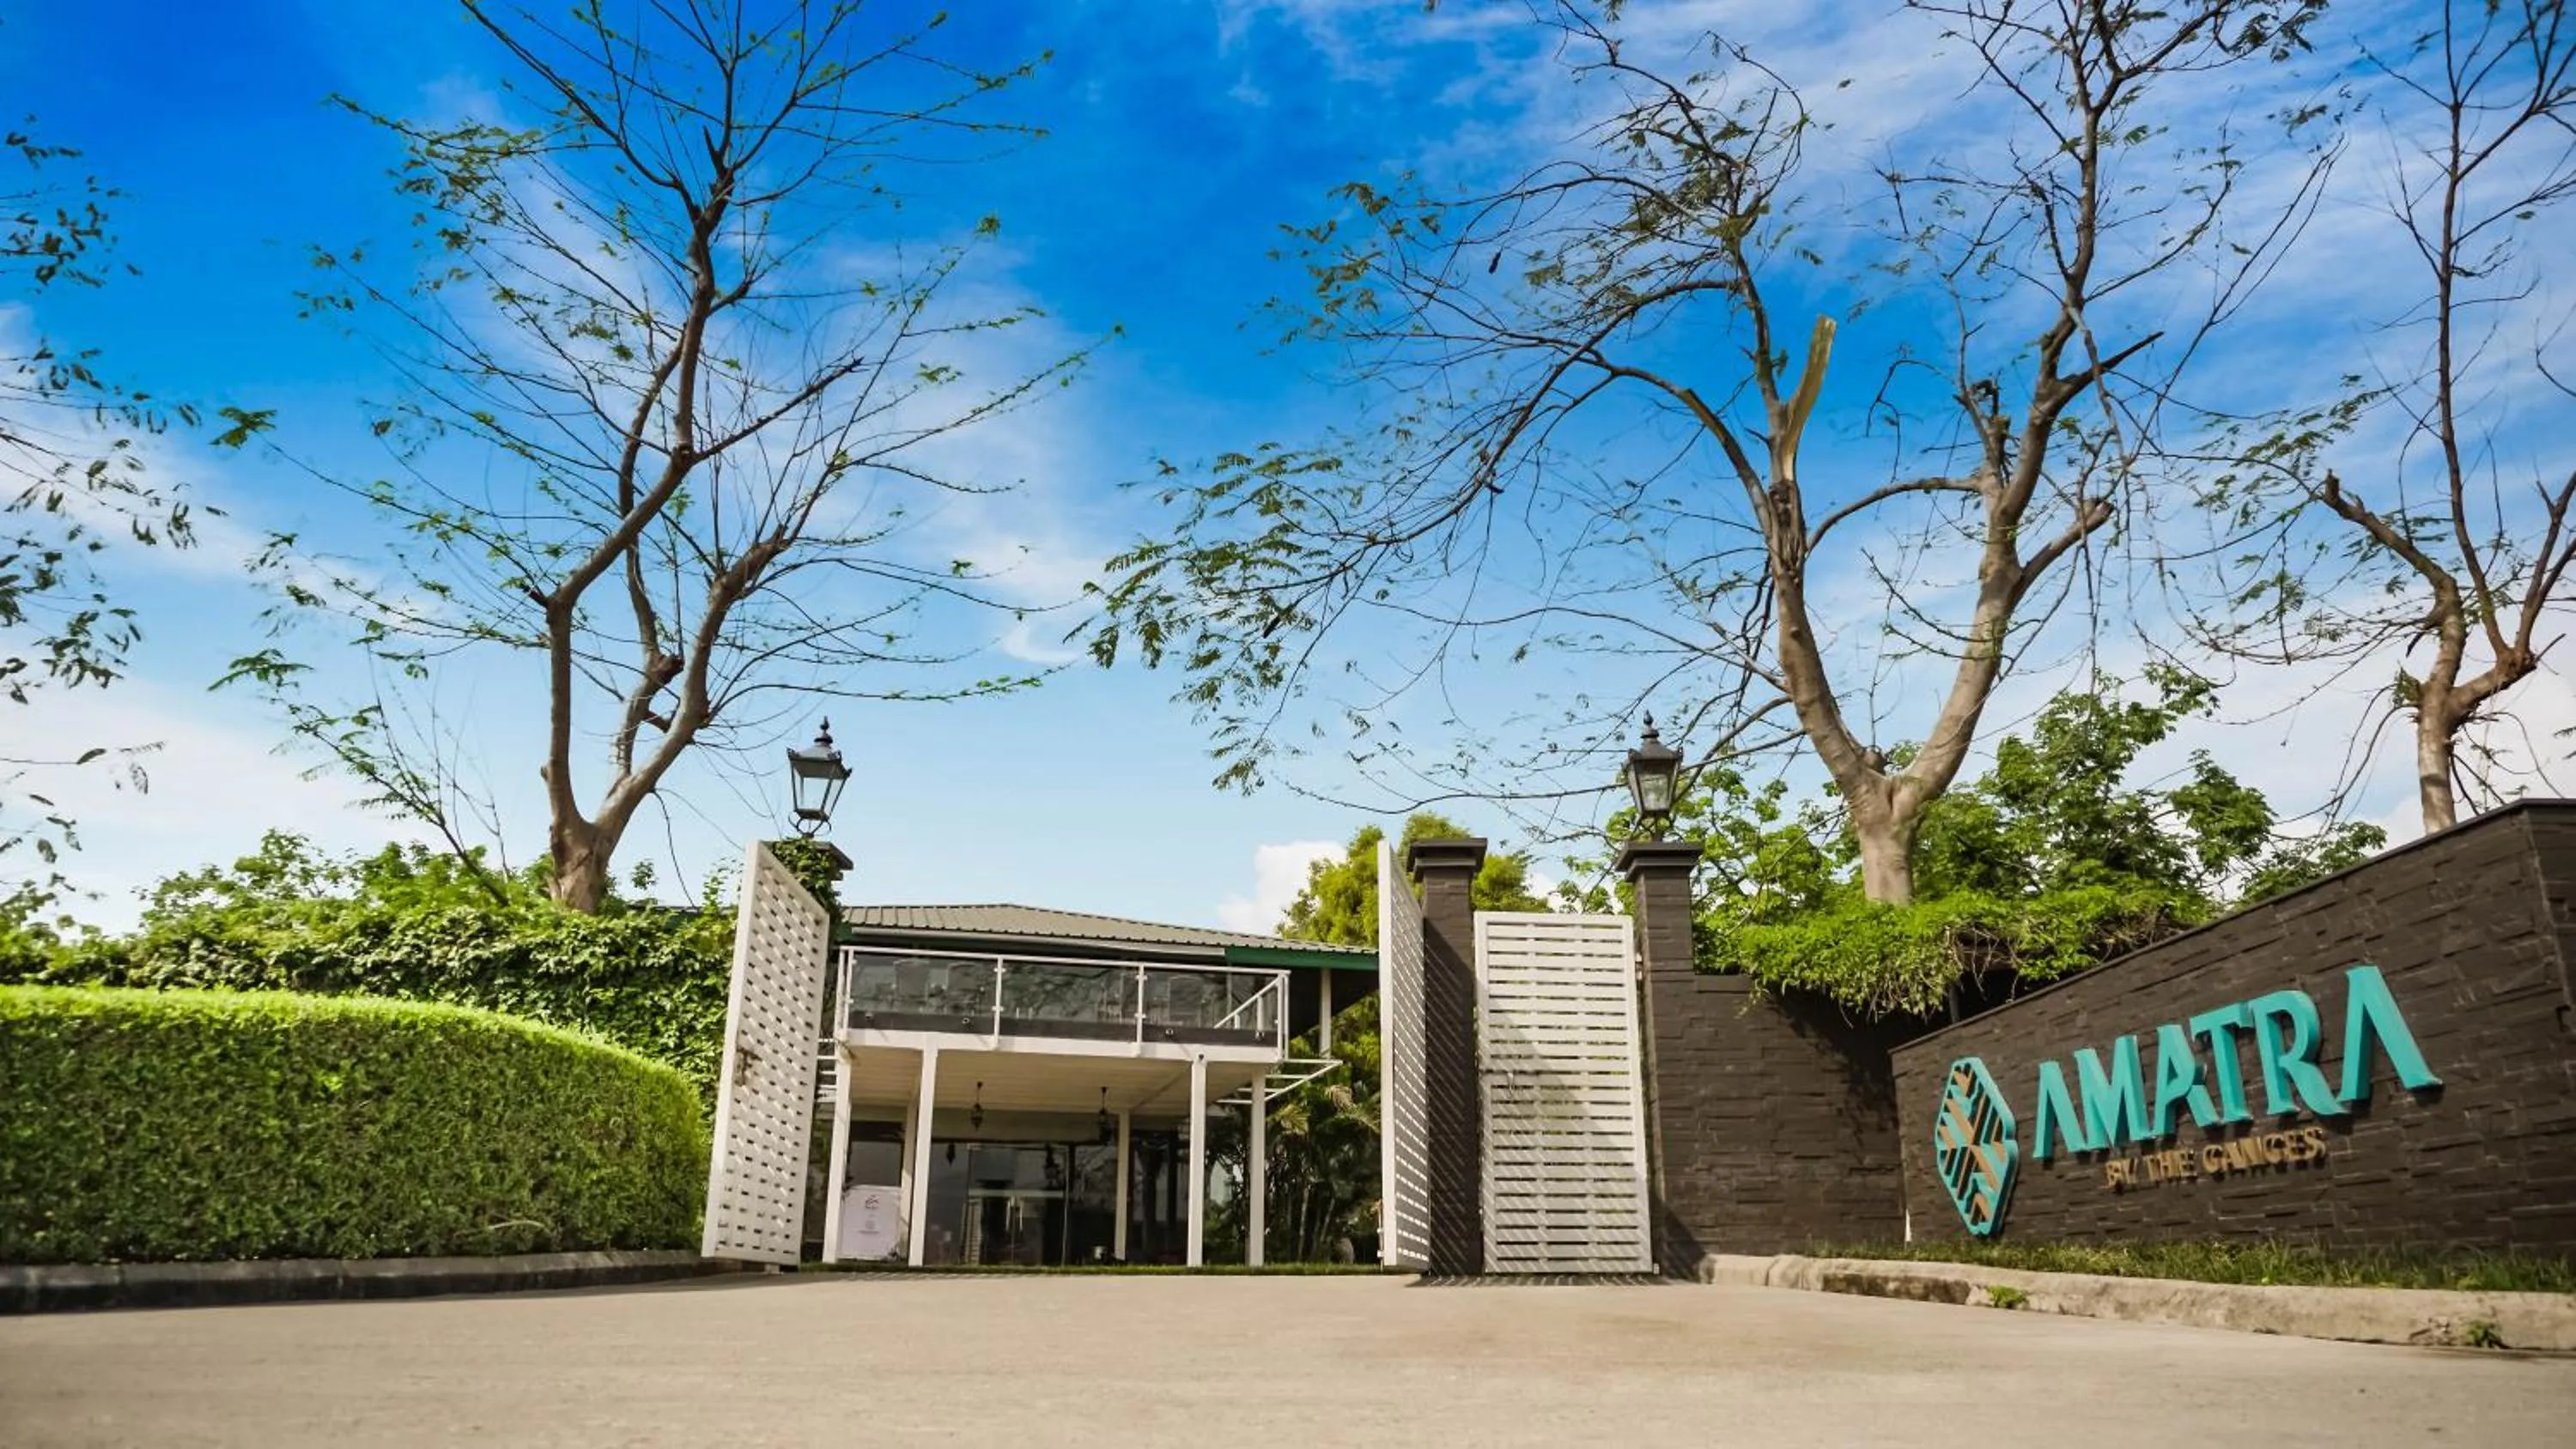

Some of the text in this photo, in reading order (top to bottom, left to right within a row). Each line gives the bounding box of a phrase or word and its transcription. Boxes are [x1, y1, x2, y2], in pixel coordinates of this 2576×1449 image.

[2032, 965, 2443, 1159] AMATRA
[2105, 1125, 2326, 1188] BY THE GANGES
